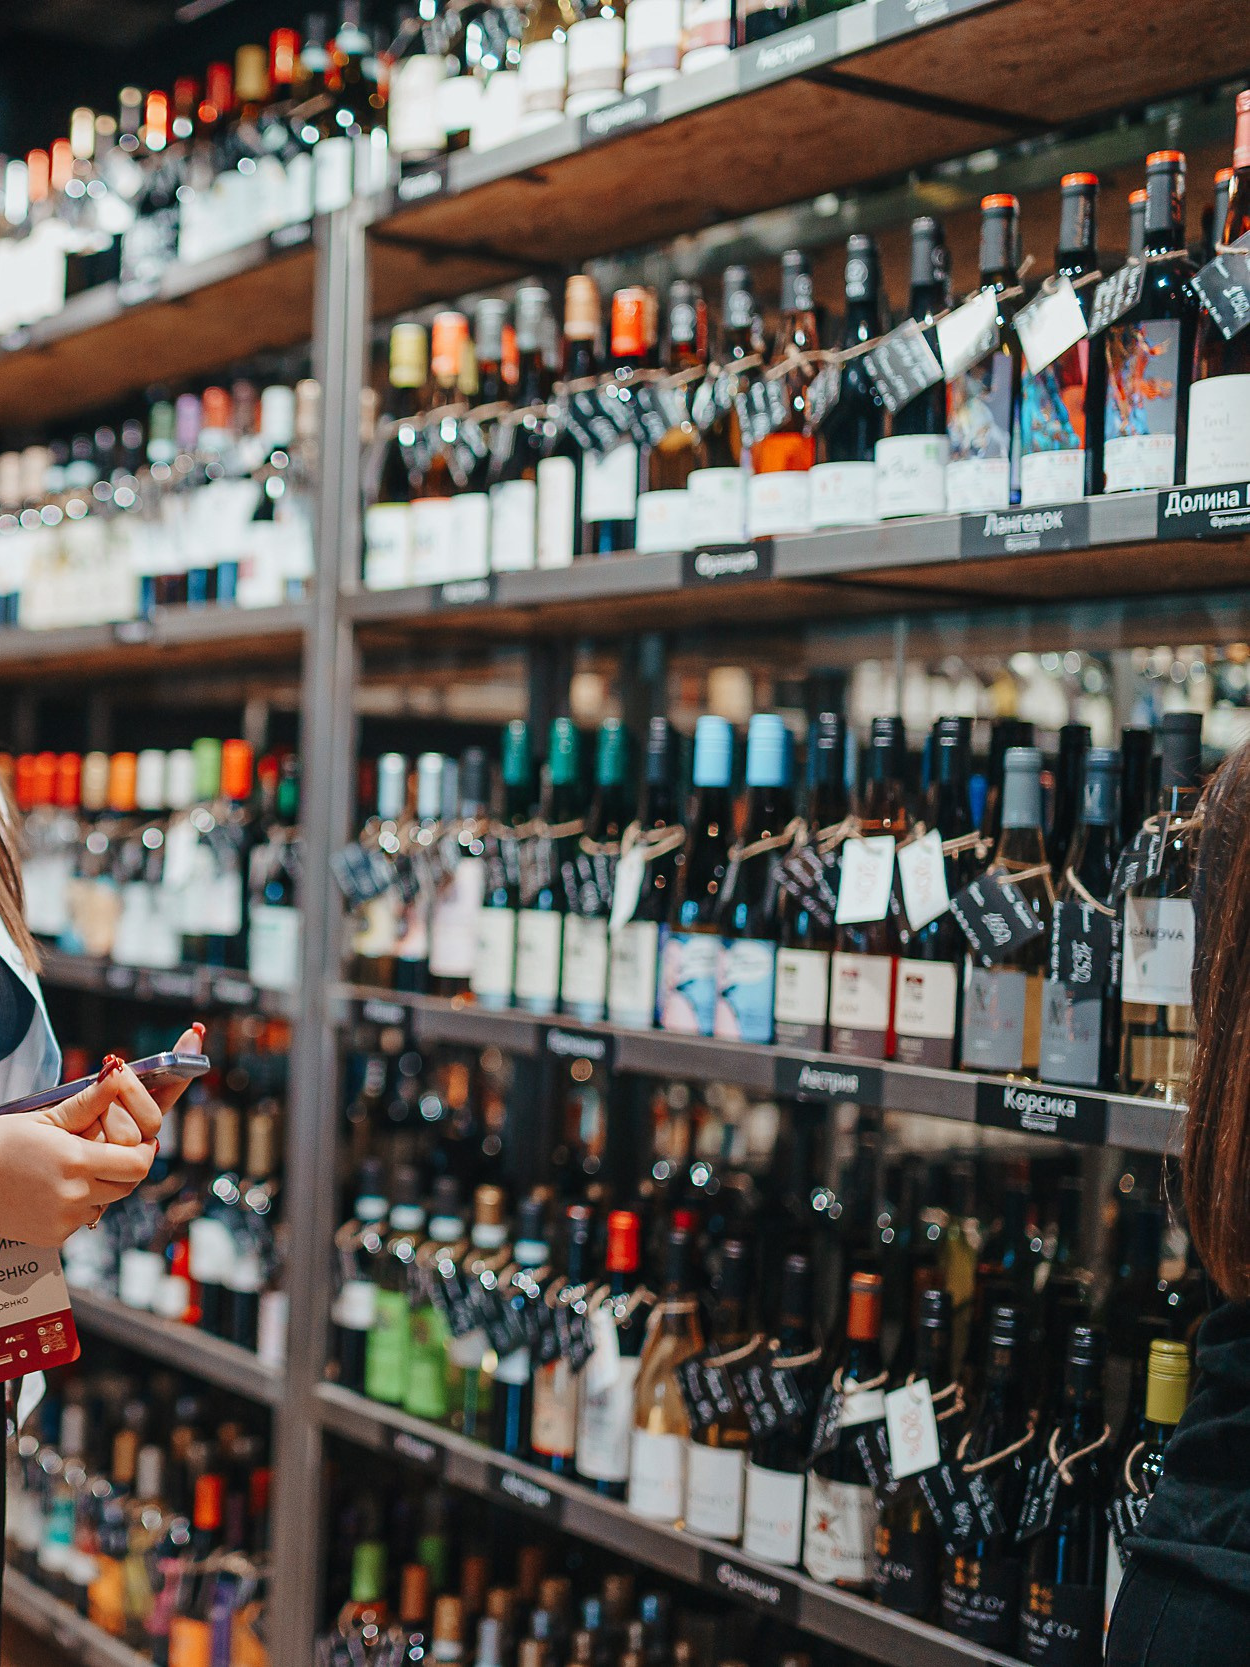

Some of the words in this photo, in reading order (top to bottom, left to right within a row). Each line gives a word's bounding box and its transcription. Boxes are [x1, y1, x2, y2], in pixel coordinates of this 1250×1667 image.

[1164, 489, 1240, 518] Долина
[983, 511, 1064, 537] Лангедок
[1003, 1087, 1077, 1118] Корсика
